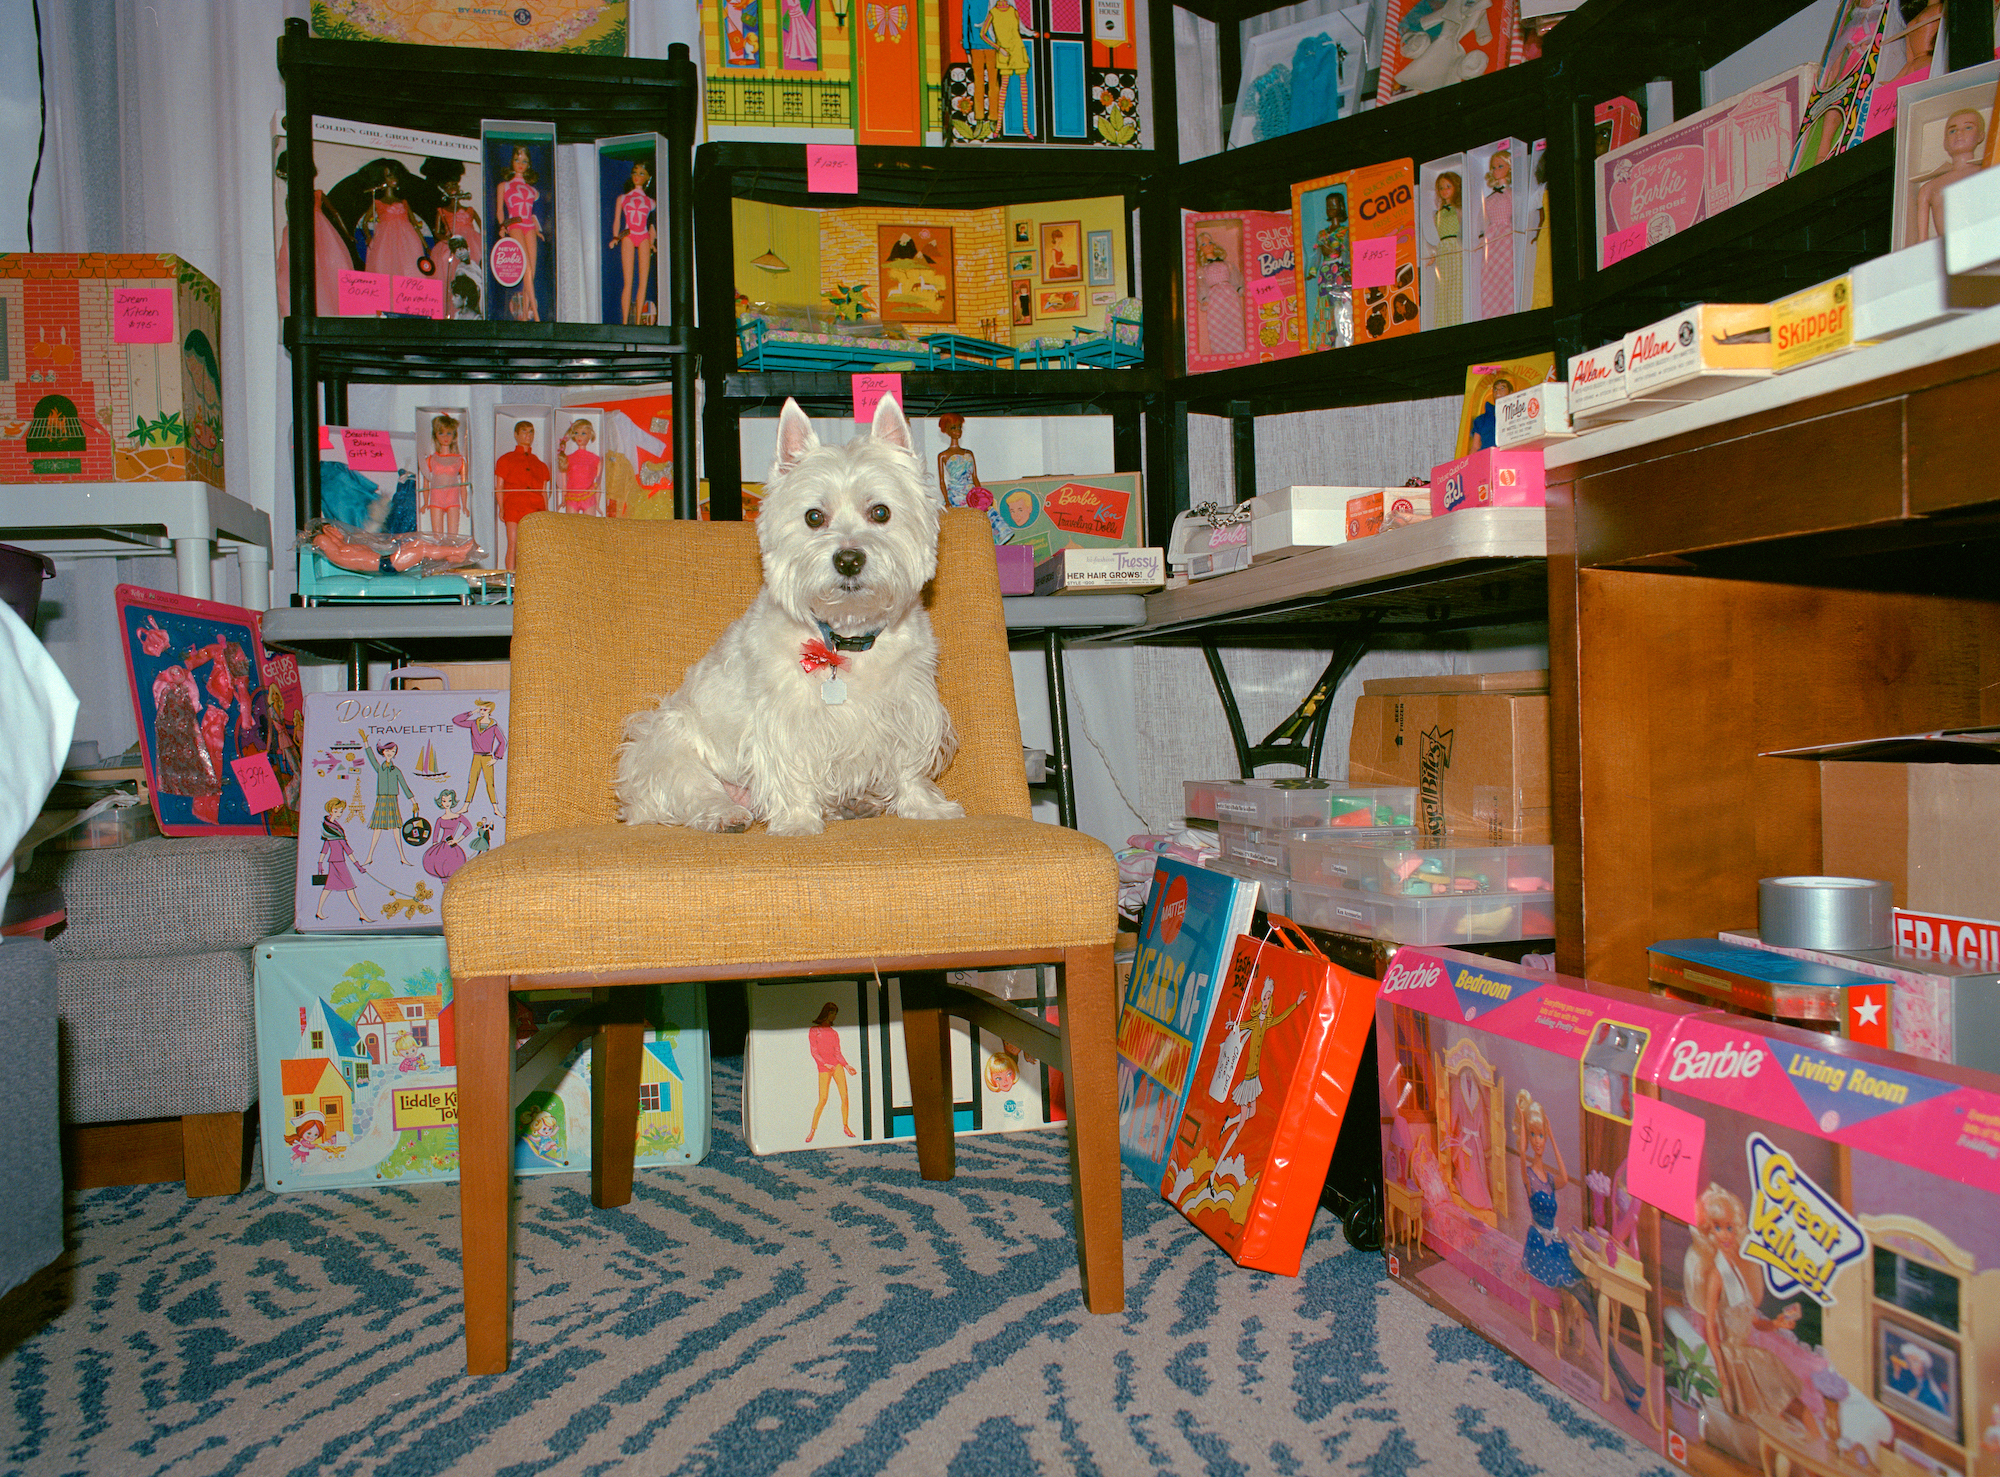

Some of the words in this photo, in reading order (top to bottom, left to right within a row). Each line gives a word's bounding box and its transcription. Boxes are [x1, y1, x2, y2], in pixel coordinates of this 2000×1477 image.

[473, 8, 509, 16] MATTEL
[315, 122, 356, 133] GOLDEN
[359, 129, 383, 138] GIRL
[385, 132, 418, 143] GROUP
[421, 137, 479, 151] COLLECTION
[1634, 163, 1657, 179] Susy
[1657, 152, 1684, 174] Goose
[1359, 184, 1412, 221] Cara
[1630, 167, 1687, 215] Barbie
[1631, 196, 1687, 222] WARDROBE
[1256, 225, 1294, 242] QUICK
[1261, 237, 1295, 251] CURL
[496, 251, 522, 265] Barbie
[1257, 248, 1295, 277] Barbi
[401, 279, 424, 291] 1996
[117, 294, 149, 304] Dream
[396, 293, 439, 304] Convention
[122, 306, 160, 318] Kitchen
[1627, 331, 1676, 371] Allan
[860, 376, 889, 390] Rare
[1571, 357, 1612, 392] Allan
[1502, 400, 1527, 422] Midge
[348, 449, 367, 458] Gift
[1058, 487, 1101, 506] Barbie
[1093, 503, 1124, 523] Ken
[1093, 519, 1117, 534] Dolls
[1208, 523, 1247, 548] Barbie
[1109, 571, 1143, 579] GROWS!
[1112, 552, 1159, 578] Tressy
[263, 656, 294, 677] GET-UPS
[336, 699, 402, 724] Dolly
[368, 724, 454, 735] TRAVELETTE
[1421, 738, 1442, 795] Bites
[1161, 898, 1186, 922] MATTEL
[1128, 943, 1186, 1026] YEARS
[1179, 970, 1209, 1036] OF
[1383, 962, 1441, 994] Barbie
[1454, 969, 1513, 1001] Bedroom
[1117, 1009, 1191, 1092] INNOVATION
[1669, 1040, 1764, 1082] Barbie
[1788, 1053, 1847, 1092] Living
[1847, 1068, 1909, 1104] Room
[400, 1093, 441, 1110] Liddle
[1128, 1073, 1180, 1165] PLAY
[1639, 1117, 1692, 1174] $169-
[1762, 1154, 1841, 1253] Great
[1753, 1189, 1836, 1291] Value!
